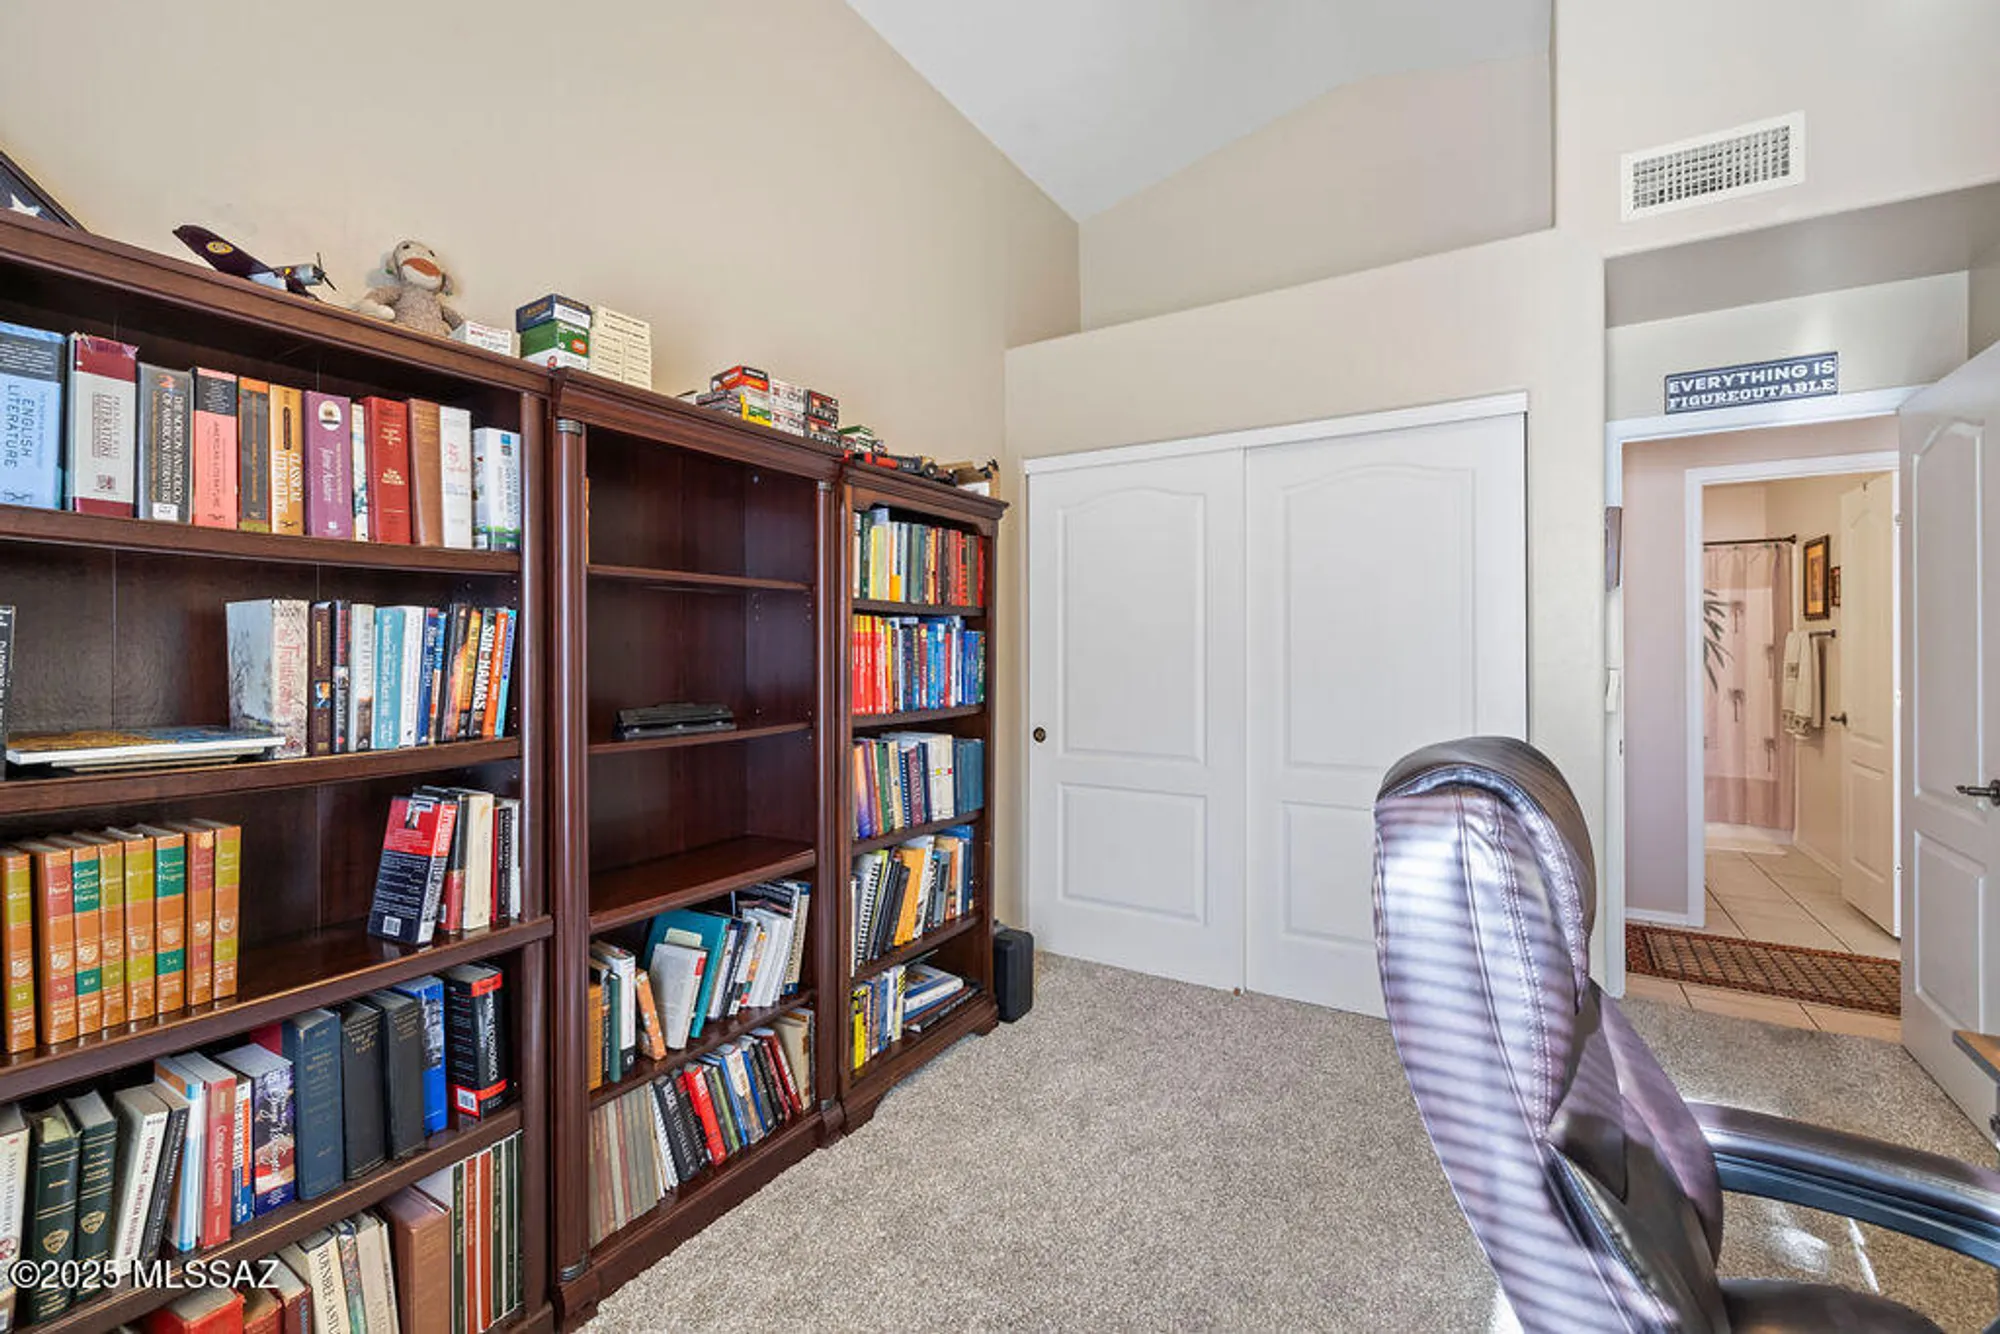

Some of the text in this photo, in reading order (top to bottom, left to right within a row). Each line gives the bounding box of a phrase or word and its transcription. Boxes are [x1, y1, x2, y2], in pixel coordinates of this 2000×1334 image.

[1669, 360, 1835, 394] EVERYTHING IS
[1669, 378, 1835, 409] FIGUREOUTABLE
[4, 383, 20, 468] LITERATURE
[22, 398, 34, 458] ENGLISH
[101, 393, 113, 458] LITERATURE
[161, 405, 173, 451] AMERICAN
[173, 414, 184, 449] NORTON
[161, 453, 173, 503] LITERATURE
[173, 452, 184, 504] ANTHOLOGY
[473, 659, 491, 711] HAMAS
